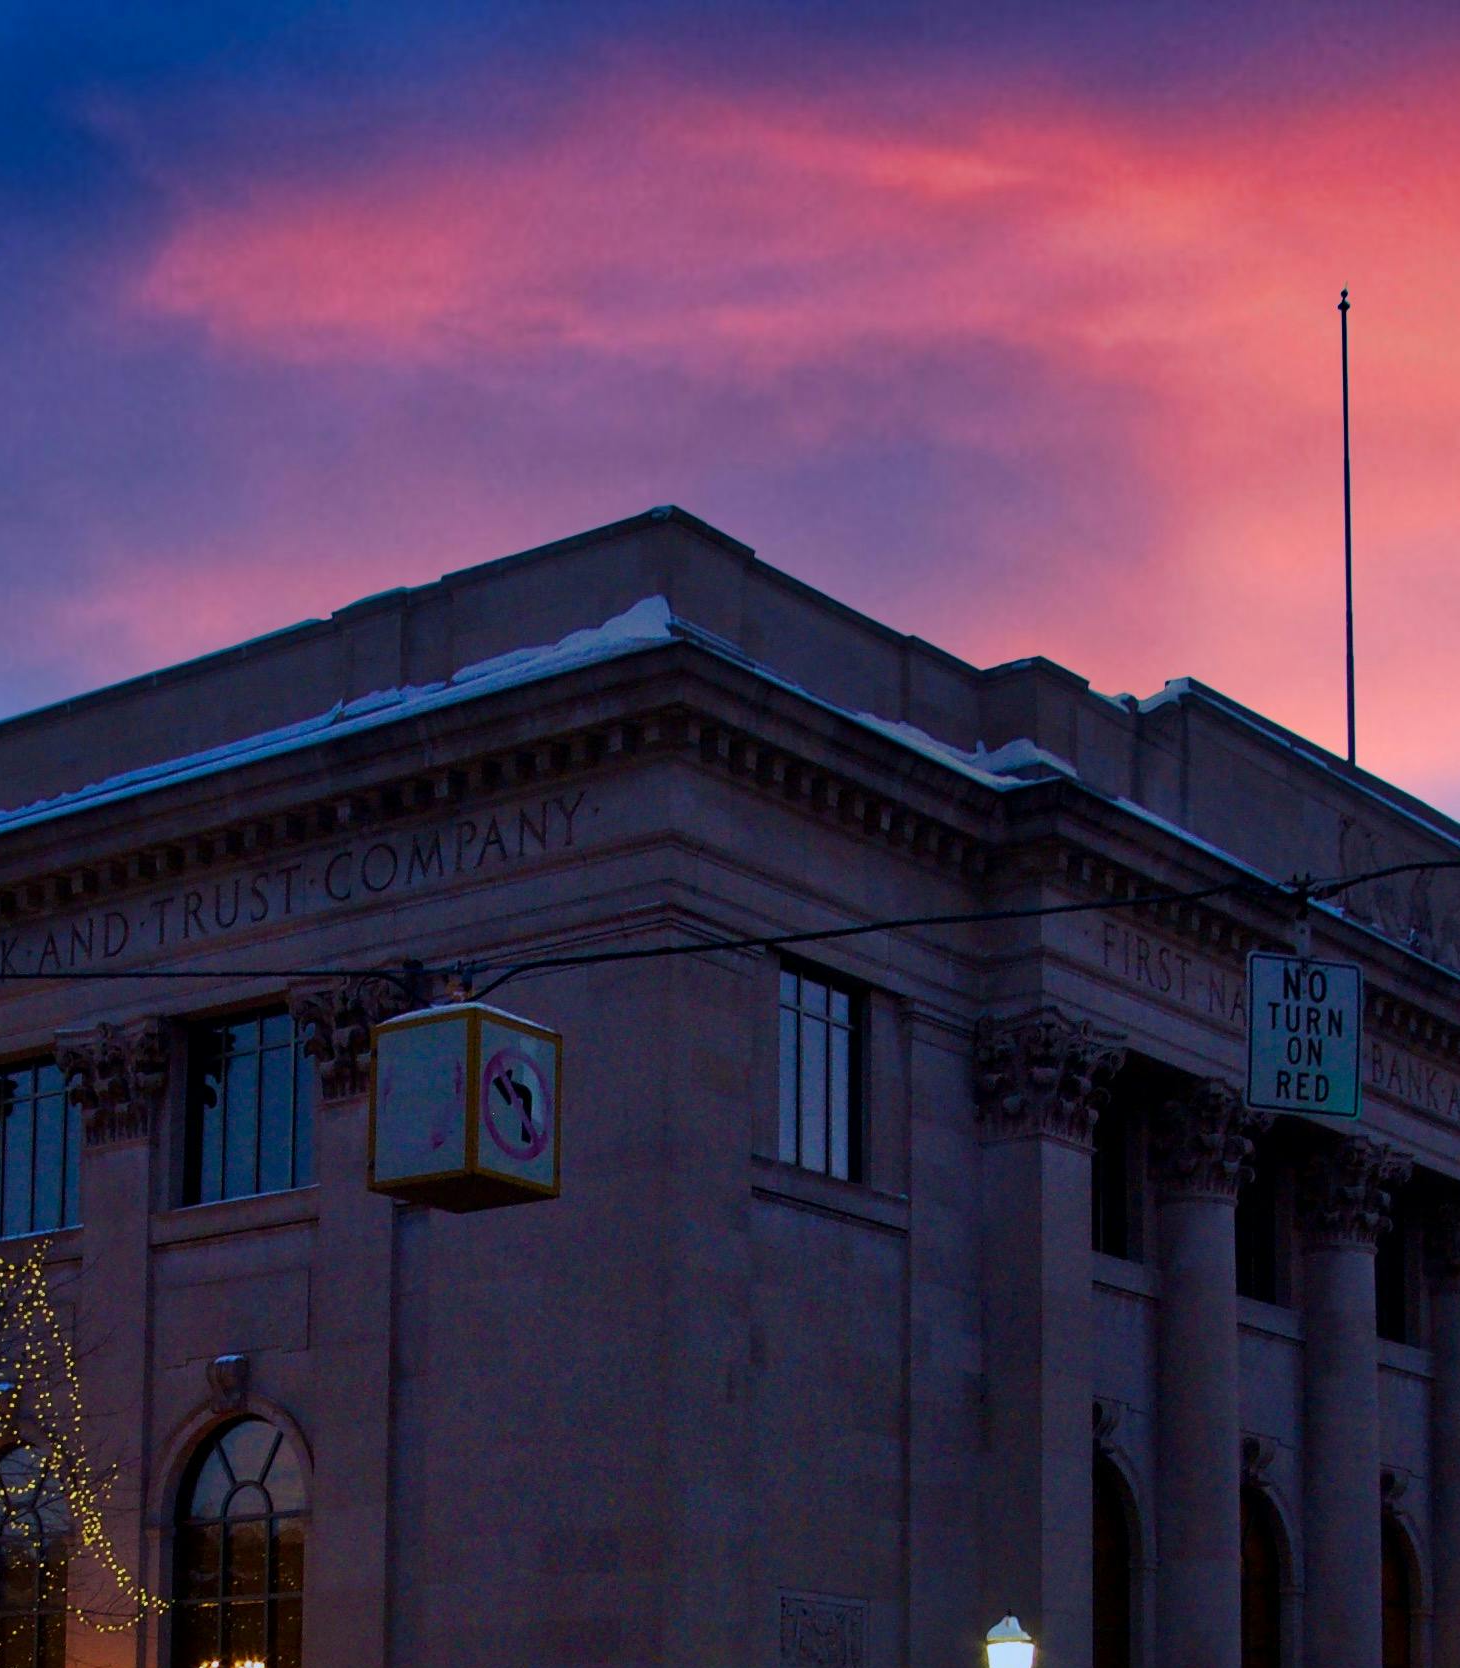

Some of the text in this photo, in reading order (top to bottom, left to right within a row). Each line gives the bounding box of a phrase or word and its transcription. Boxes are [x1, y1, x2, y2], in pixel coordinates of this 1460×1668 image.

[40, 910, 129, 971] AND
[149, 863, 303, 944] TRUST
[324, 791, 588, 900] COMPANY
[1283, 967, 1327, 1002] NO
[1103, 921, 1191, 1000] FIRST
[1372, 1043, 1439, 1110] BANK
[1267, 1002, 1343, 1037] TURN
[1287, 1037, 1323, 1066] ON
[1276, 1070, 1330, 1102] RED
